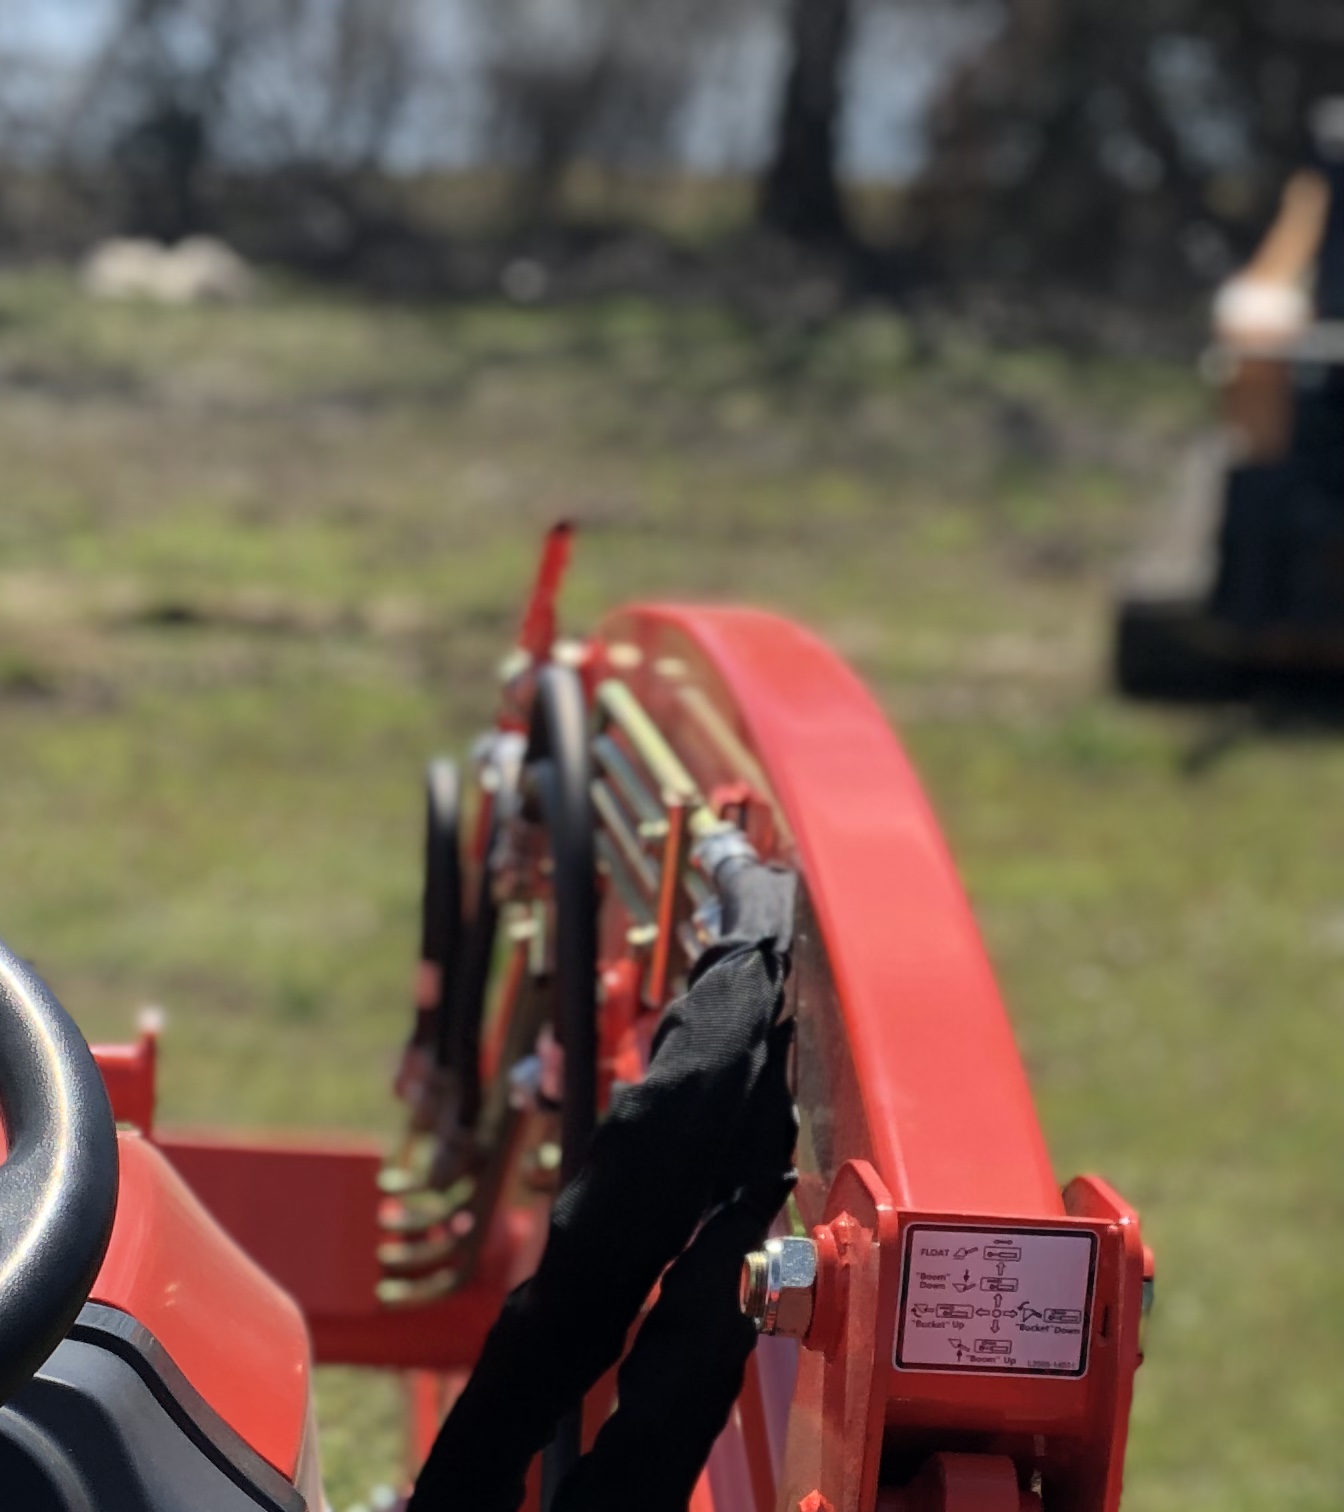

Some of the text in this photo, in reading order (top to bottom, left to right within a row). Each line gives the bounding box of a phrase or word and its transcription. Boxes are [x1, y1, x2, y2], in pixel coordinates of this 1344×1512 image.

[920, 1248, 950, 1257] FLOAT
[919, 1281, 946, 1290] Down
[952, 1320, 965, 1330] Up
[1054, 1326, 1081, 1335] Down
[1003, 1356, 1017, 1365] Up
